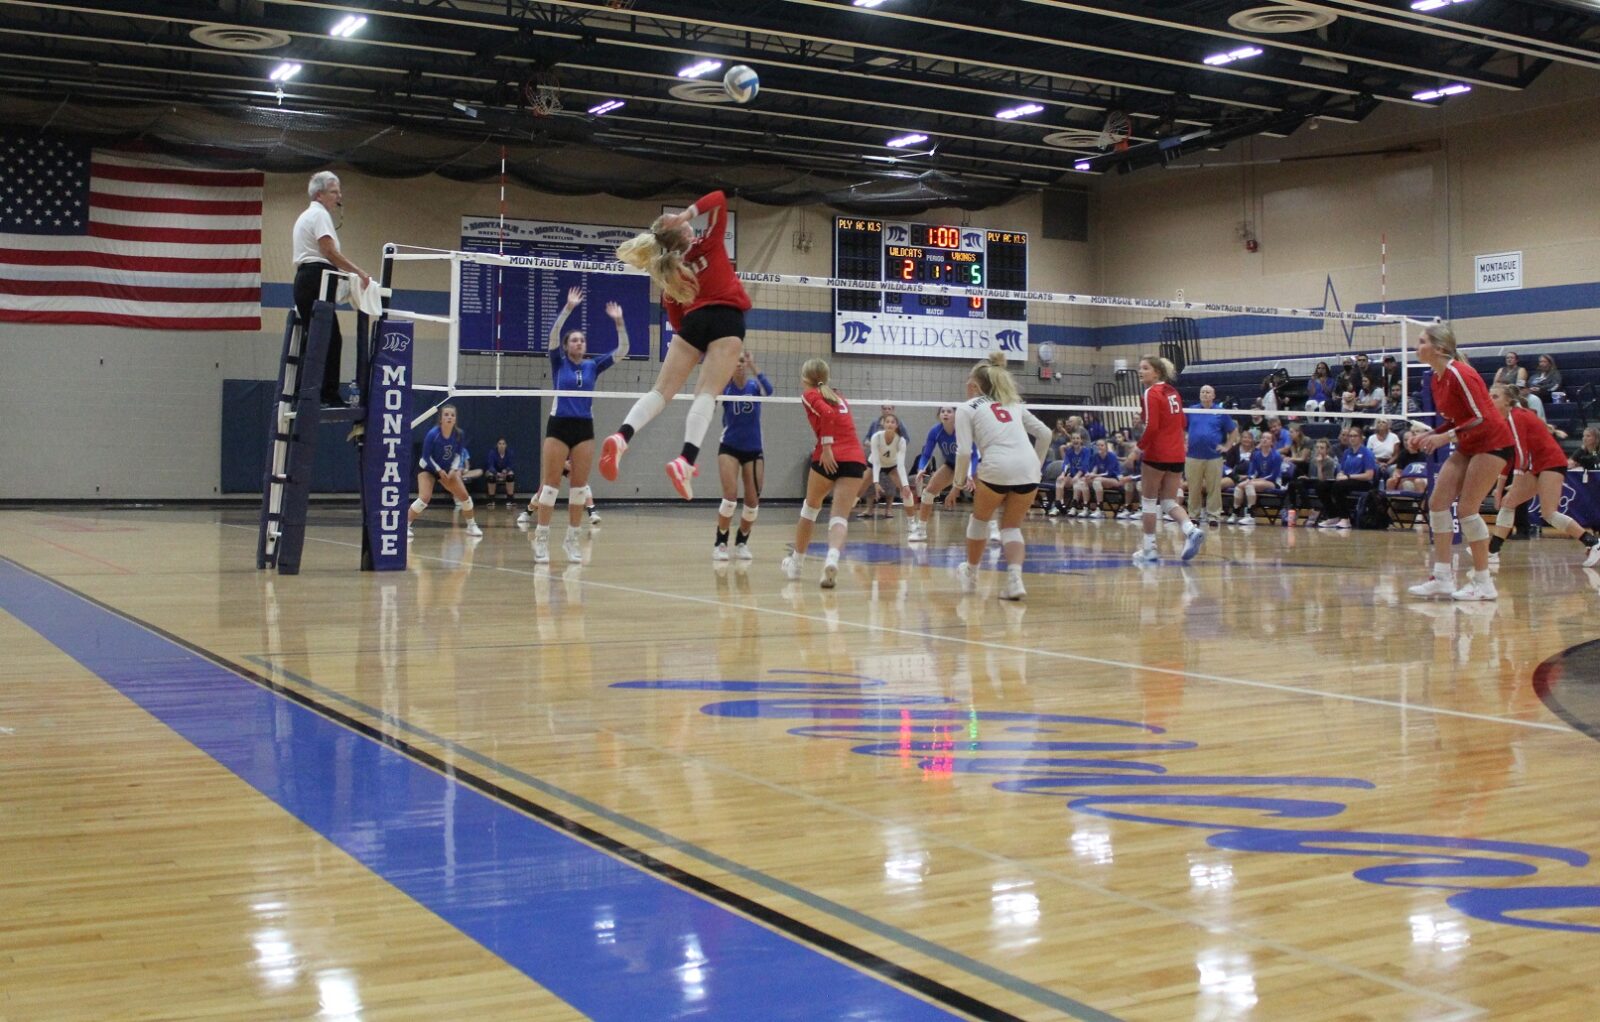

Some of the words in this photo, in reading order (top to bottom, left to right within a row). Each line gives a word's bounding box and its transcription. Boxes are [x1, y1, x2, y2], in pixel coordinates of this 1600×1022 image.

[839, 219, 852, 229] PLY
[856, 221, 865, 230] AC
[867, 222, 881, 232] KLS
[597, 230, 637, 240] MONTAG
[928, 227, 959, 248] 1:00
[988, 232, 1000, 242] PLY
[1003, 233, 1011, 243] AC
[1013, 234, 1026, 244] KLS
[889, 247, 923, 258] WILDCATS
[926, 254, 944, 262] PERIOD
[951, 253, 977, 262] VIKINGS
[509, 256, 568, 268] MONTAGUE
[573, 258, 625, 272] WILDCATS
[903, 260, 914, 280] 2
[1480, 261, 1517, 272] MONTAGUE
[971, 265, 981, 284] 5
[1483, 272, 1515, 283] PARENTS
[827, 278, 877, 290] MONTAGUE
[880, 281, 923, 292] WILDCATS
[965, 288, 1010, 298] MONTAGUE
[1013, 291, 1053, 301] WILDCATS
[1091, 296, 1132, 306] MONTAGUE
[1135, 298, 1171, 308] WILDCATS
[886, 306, 903, 314] SCORE
[926, 308, 944, 316] MATCH
[1205, 303, 1242, 313] MONTAGUE
[1245, 306, 1278, 315] WILDCATS
[1309, 310, 1344, 319] MONTAGUE
[1346, 312, 1377, 321] WILDCATS
[879, 325, 990, 349] WILDCATS
[1168, 395, 1180, 414] 15
[990, 402, 1013, 423] 6
[443, 444, 453, 460] 3
[883, 450, 890, 458] 4
[380, 365, 406, 556] MONTAGUE
